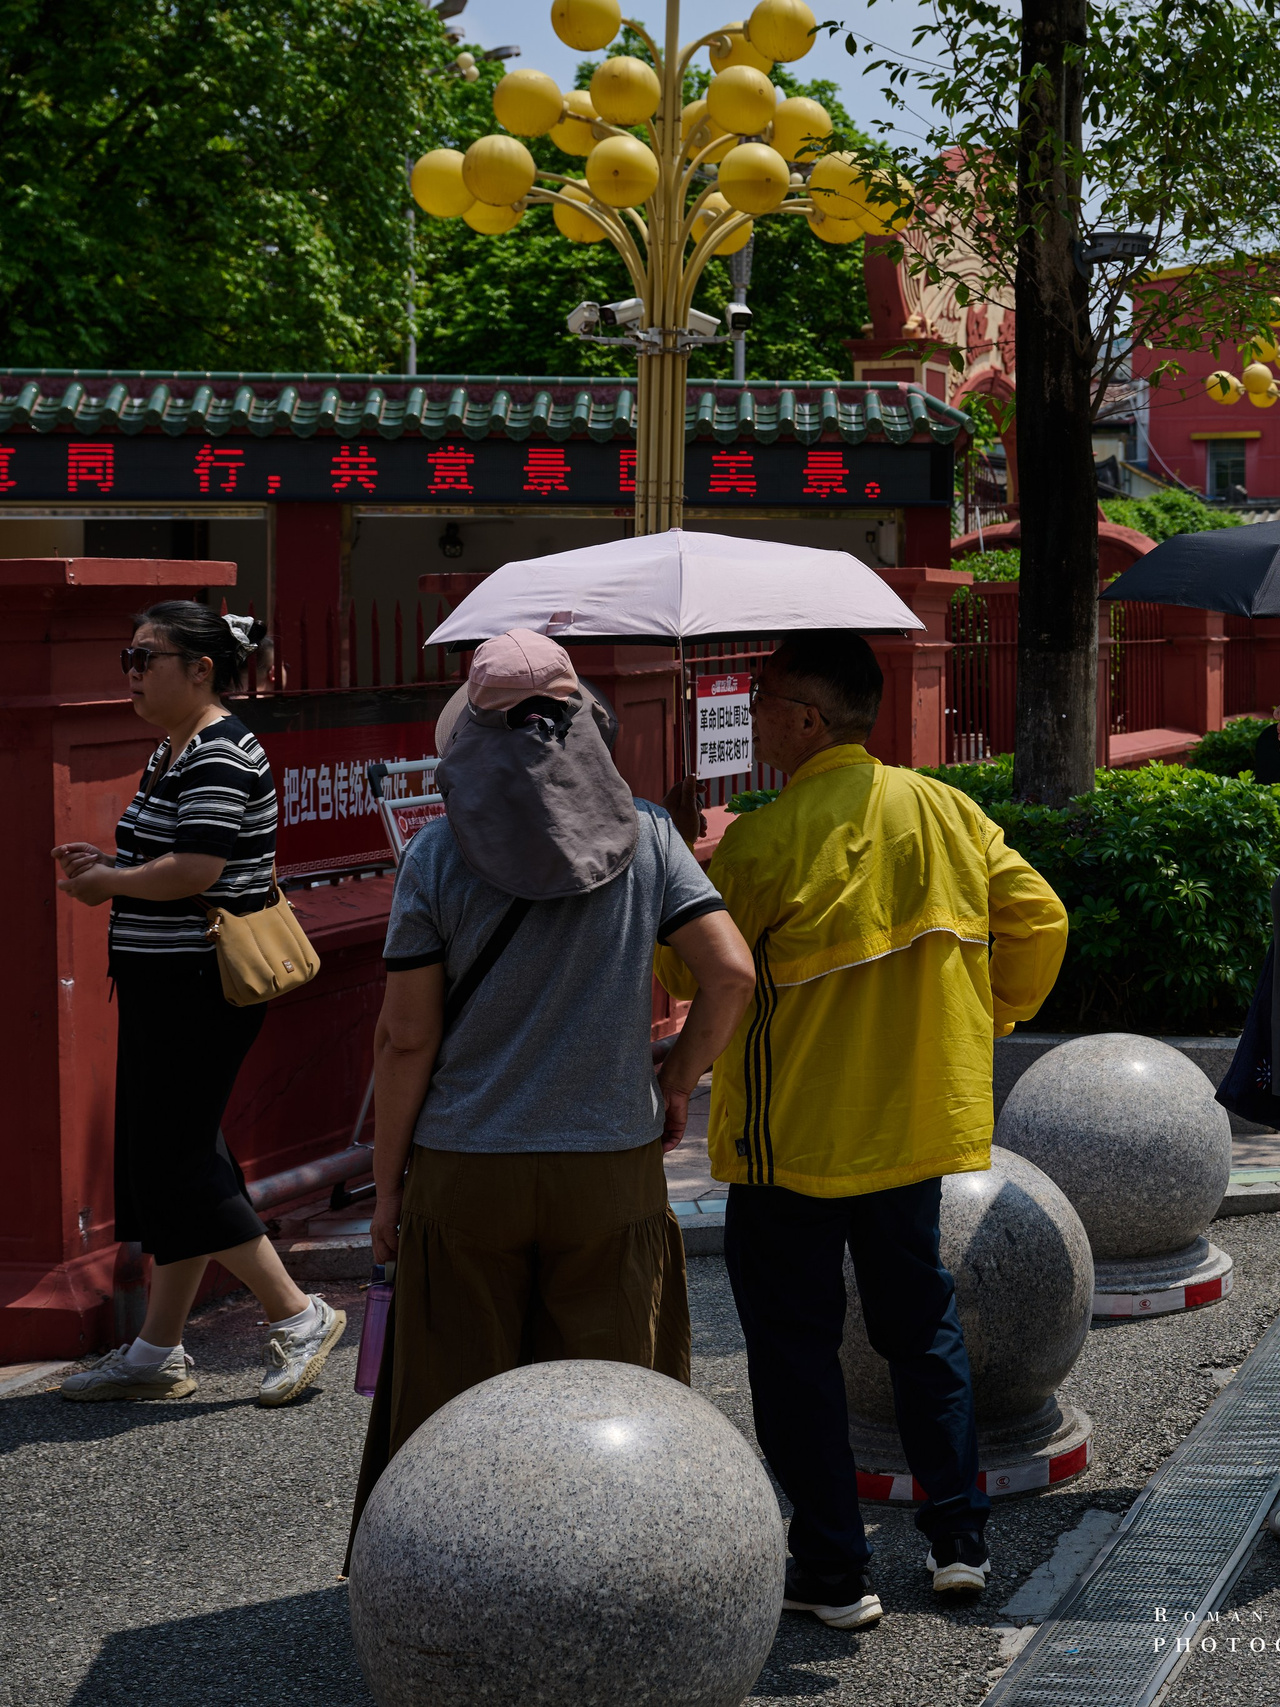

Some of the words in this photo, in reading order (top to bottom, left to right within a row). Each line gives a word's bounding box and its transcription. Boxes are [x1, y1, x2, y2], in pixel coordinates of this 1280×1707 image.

[700, 704, 749, 731] 革命旧址周边
[699, 737, 749, 765] 严禁烟花炮竹
